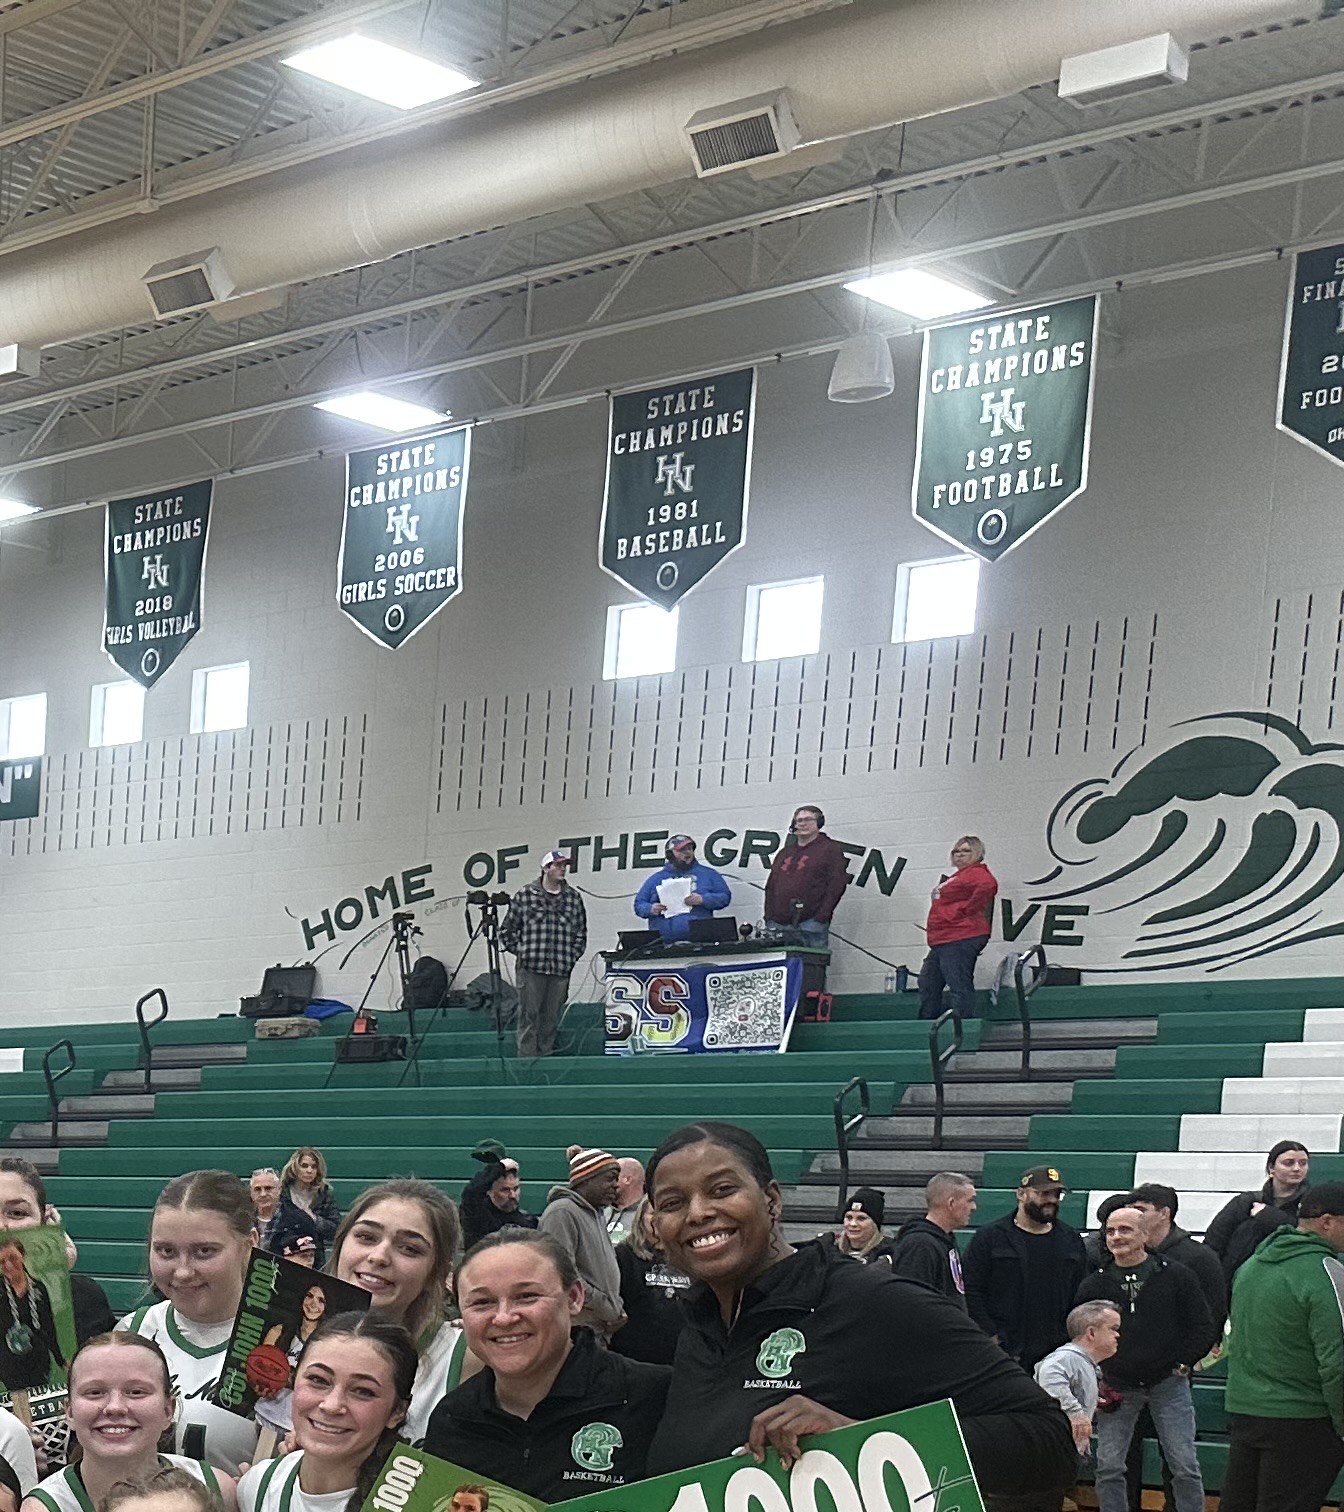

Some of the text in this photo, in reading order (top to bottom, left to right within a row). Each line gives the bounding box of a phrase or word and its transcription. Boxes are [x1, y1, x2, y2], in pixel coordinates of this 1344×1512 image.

[969, 315, 1050, 355] STATE
[931, 341, 1085, 393] CHAMPIONS
[647, 385, 716, 420] STATE
[979, 388, 1025, 437] HN
[614, 409, 744, 455] CHAMPIONS
[376, 444, 436, 475] STATE
[654, 452, 696, 495] HN
[966, 440, 1032, 471] 1975
[350, 466, 460, 507] CHAMPIONS
[932, 464, 1063, 509] FOOTBALL
[134, 496, 183, 524] STATE
[385, 504, 419, 545] HN
[647, 501, 699, 525] 1981
[113, 518, 202, 554] CHAMPIONS
[617, 521, 726, 560] BASEBALL
[142, 554, 170, 590] HN
[374, 548, 425, 572] 2006
[342, 566, 456, 604] GIRLS SOCCER
[134, 595, 173, 616] 2018
[301, 864, 435, 951] HOME
[463, 845, 529, 888] OF
[558, 830, 669, 873] THE
[245, 1258, 275, 1311] 1000
[742, 1379, 802, 1389] BASKETBALL
[563, 1471, 625, 1484] BASKETBALL
